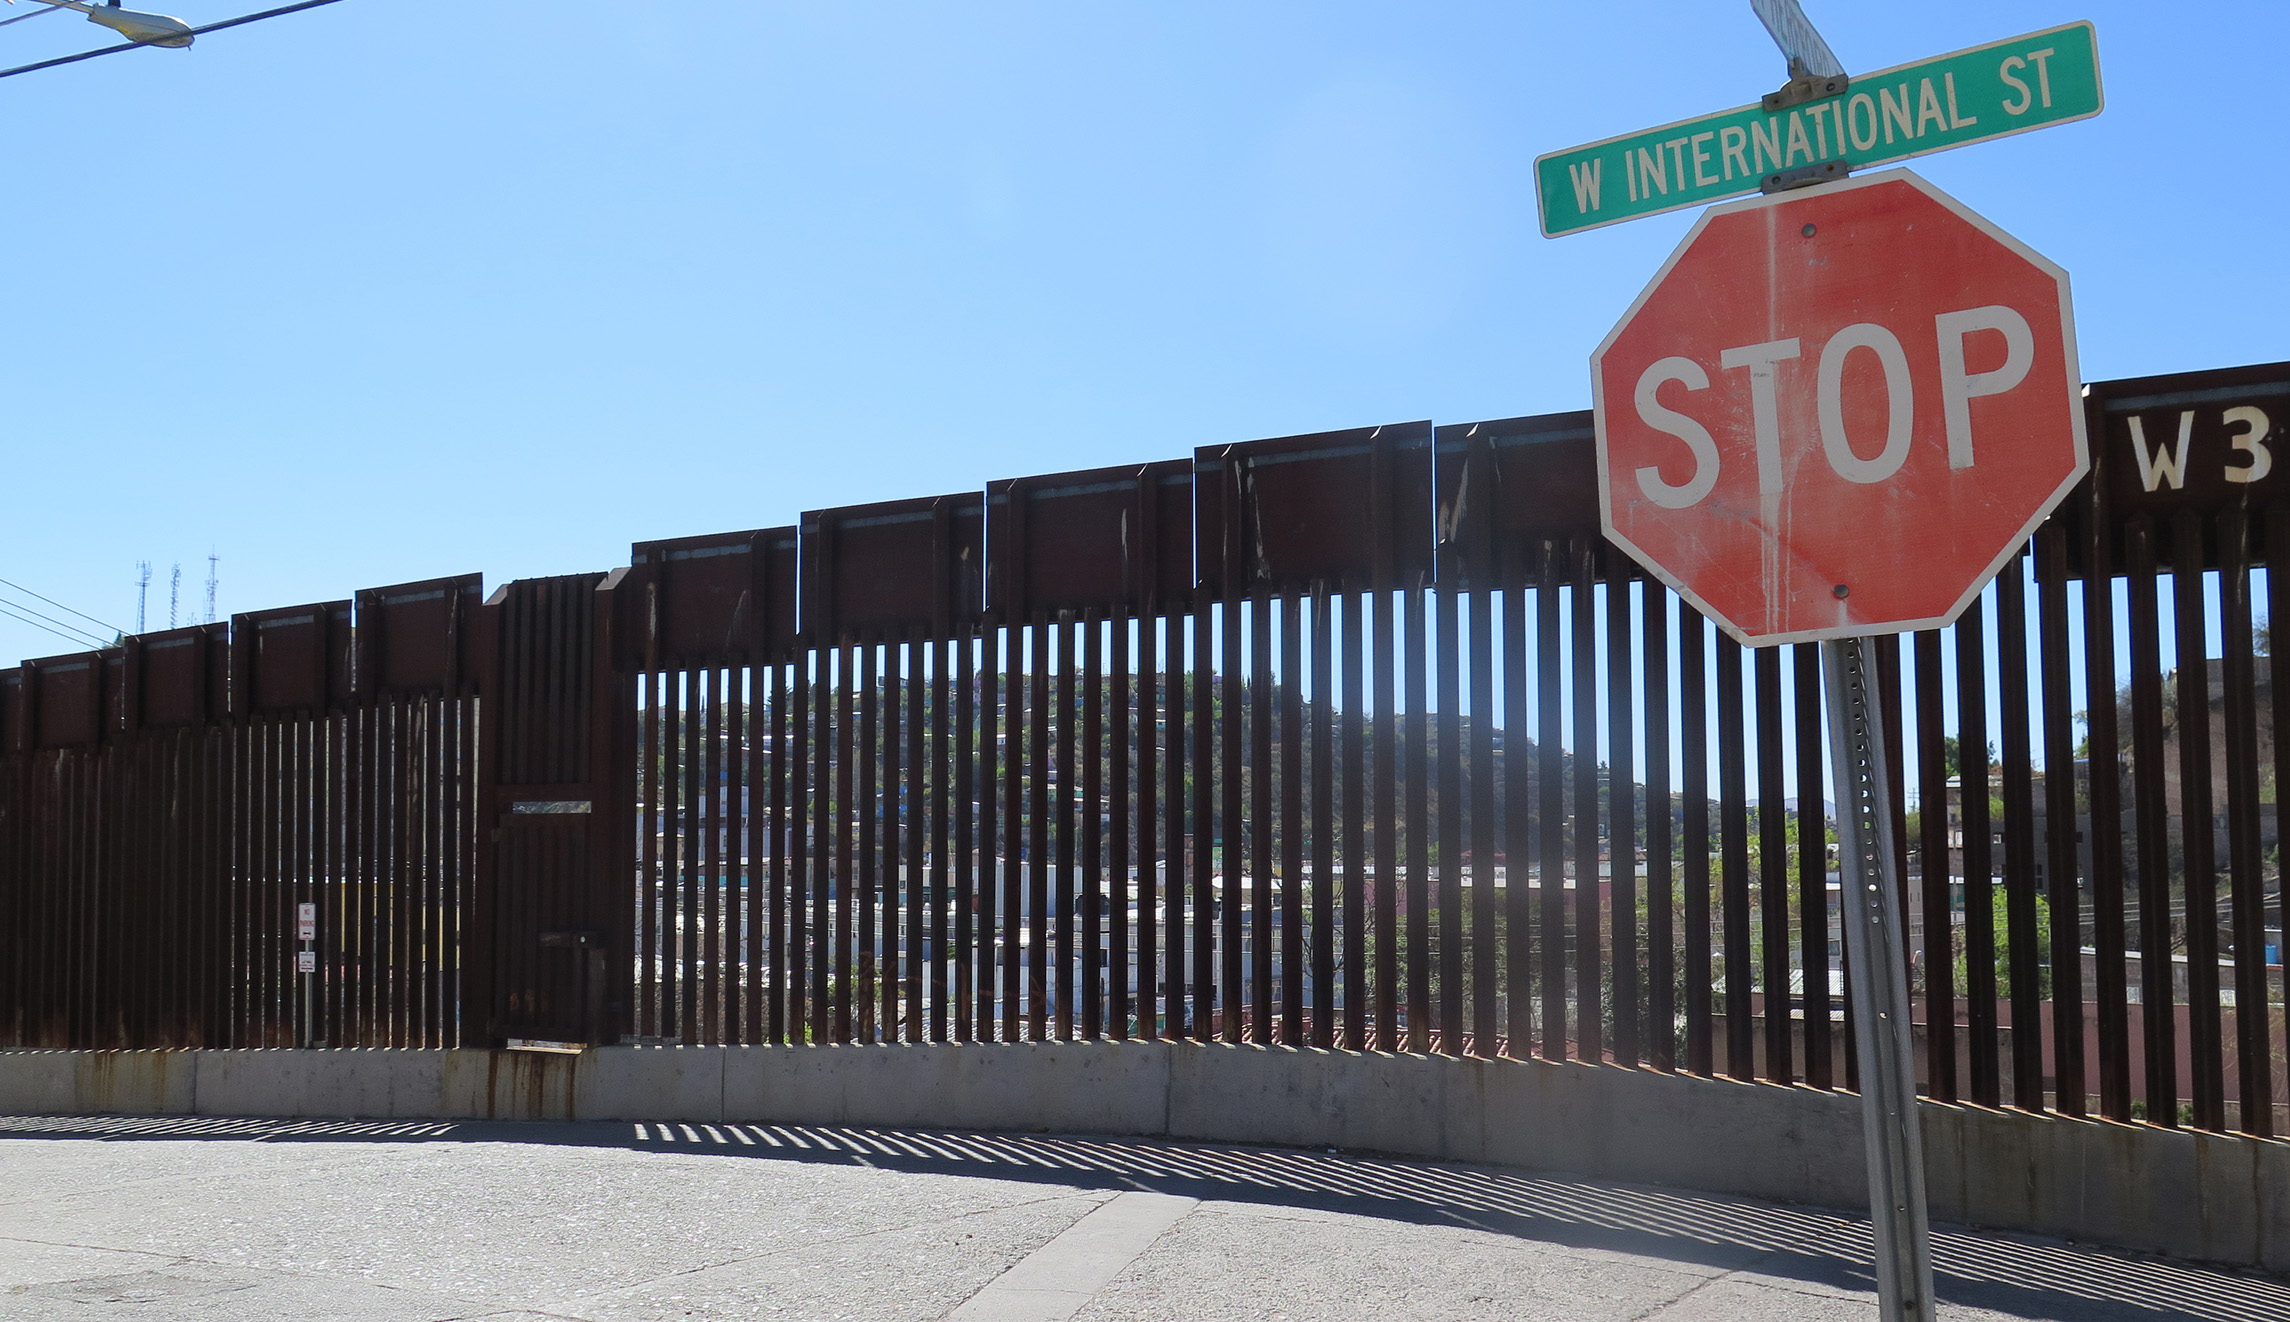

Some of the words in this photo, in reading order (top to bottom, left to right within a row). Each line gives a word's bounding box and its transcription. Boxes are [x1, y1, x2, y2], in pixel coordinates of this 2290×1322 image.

[1568, 157, 1601, 214] W
[1625, 72, 1978, 202] INTERNATIONAL
[2000, 47, 2055, 116] ST
[1633, 304, 2036, 510] STOP
[2127, 410, 2195, 492] W
[2222, 405, 2273, 484] 3
